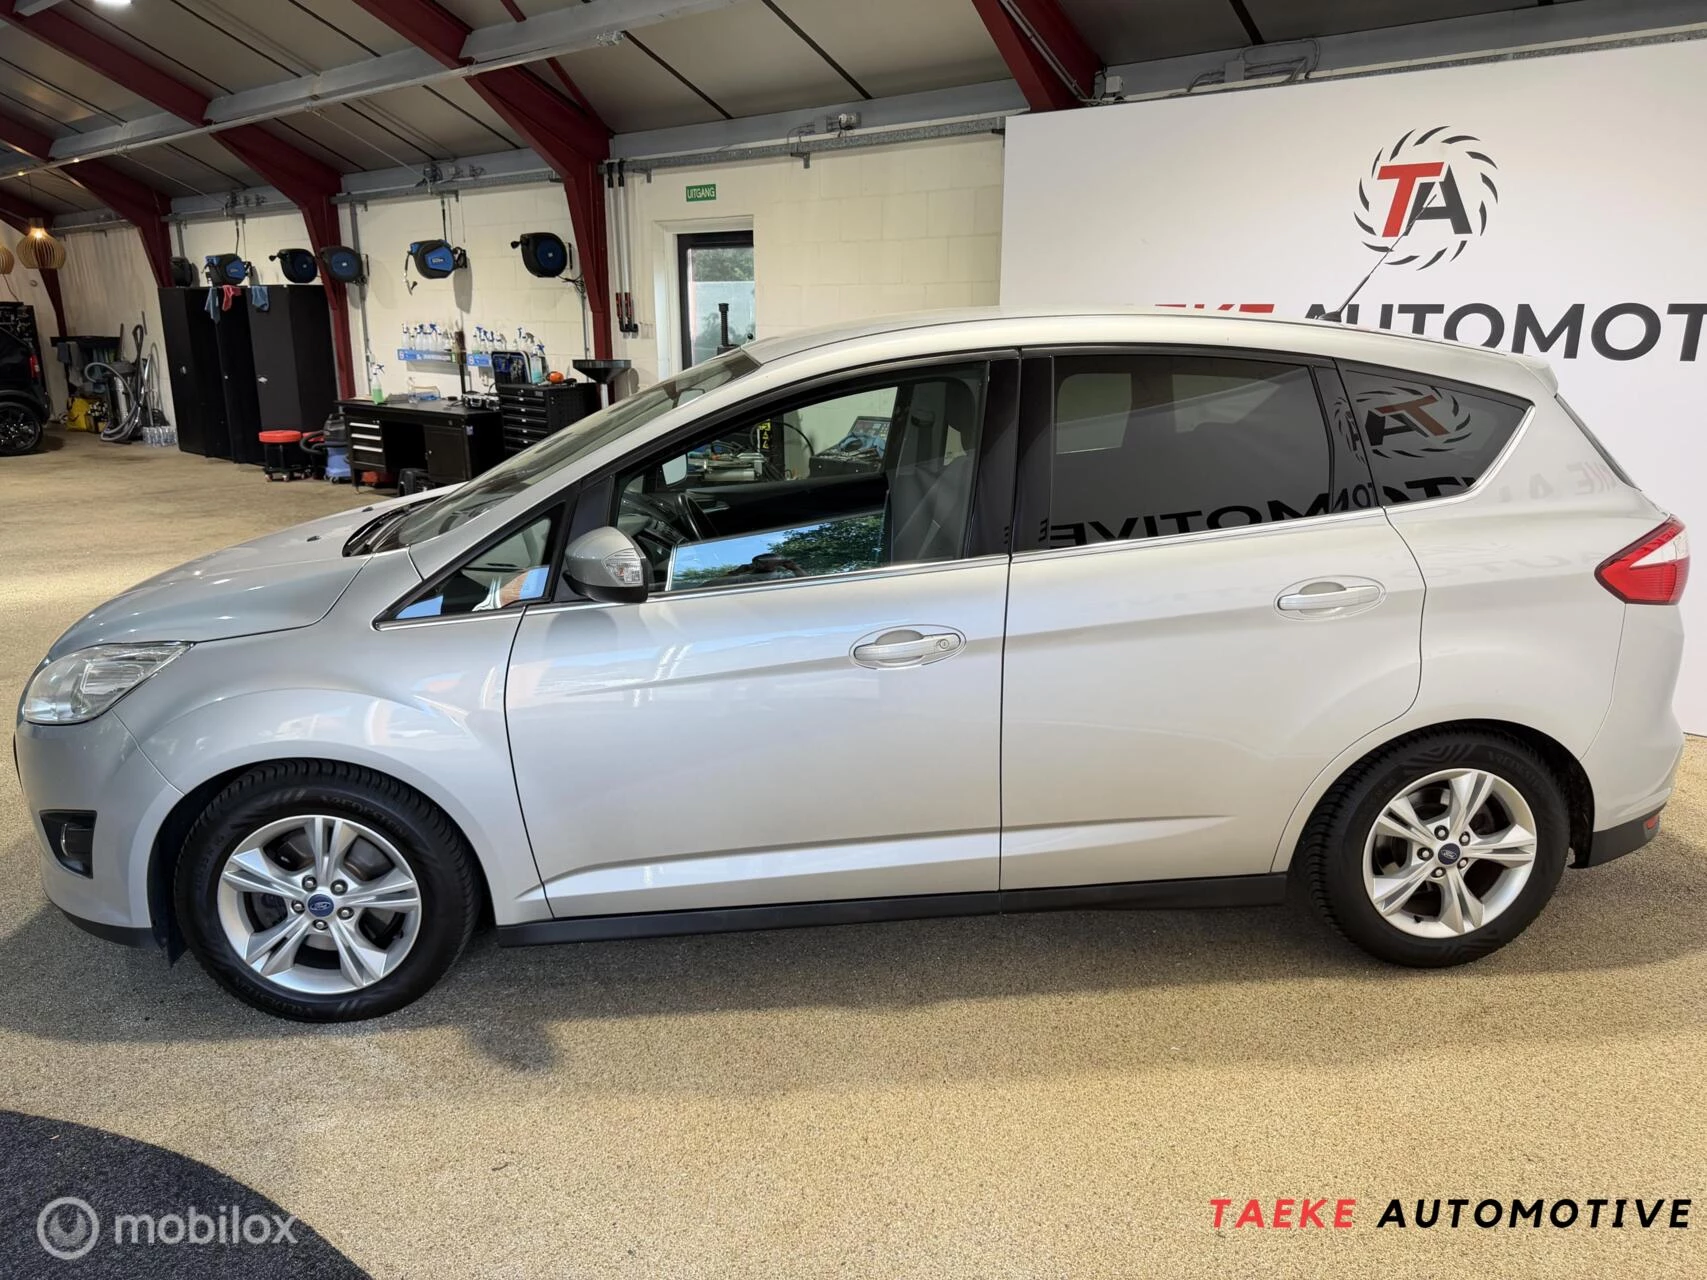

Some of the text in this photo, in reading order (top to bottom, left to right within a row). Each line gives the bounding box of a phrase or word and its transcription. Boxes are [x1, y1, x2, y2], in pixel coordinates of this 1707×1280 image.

[687, 187, 715, 199] UITGANG
[1377, 162, 1473, 238] TA
[1305, 302, 1707, 362] TOMOT
